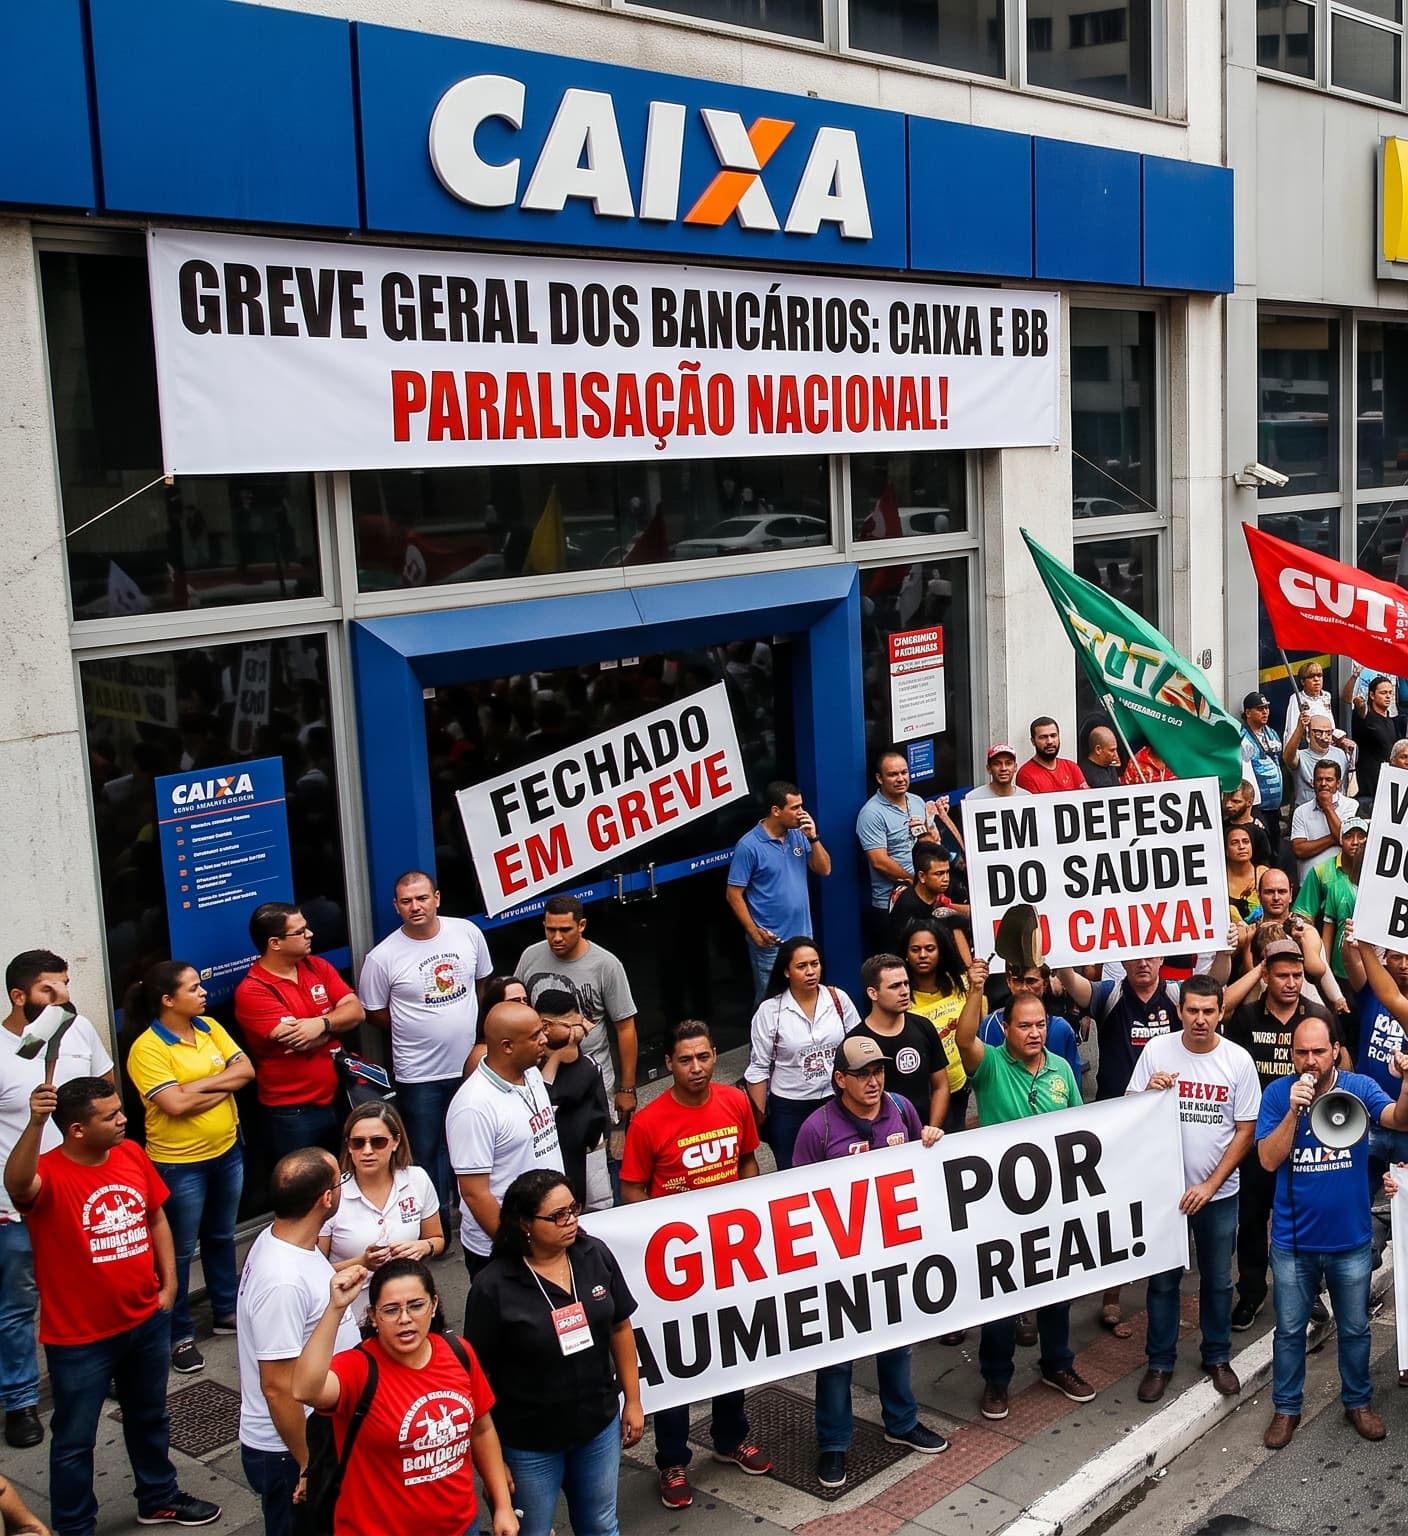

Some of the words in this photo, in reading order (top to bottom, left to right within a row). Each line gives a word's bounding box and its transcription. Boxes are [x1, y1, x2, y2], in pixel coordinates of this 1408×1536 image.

[428, 74, 874, 241] CAIXA
[179, 259, 367, 340] GREVE
[381, 271, 538, 345] GERAL
[550, 282, 639, 348] DOS
[652, 284, 880, 355] BANCÁRIOS:
[889, 301, 983, 356] CAIXA
[991, 307, 1004, 357] E
[1011, 308, 1049, 358] BB
[391, 360, 736, 451] PARALISAÇÃO
[748, 374, 950, 436] NACIONAL!
[1279, 567, 1395, 633] CUT
[171, 773, 255, 806] CAIXA
[487, 703, 711, 836] FECHADO
[493, 831, 572, 898] EM
[585, 749, 736, 853] GREVE
[974, 806, 1039, 853] EM
[1054, 790, 1213, 848] DEFESA
[986, 860, 1046, 907] DO
[1063, 838, 1209, 900] SAÚDE
[1068, 897, 1215, 954] CAIXA!
[682, 1136, 738, 1169] CUT
[1293, 1148, 1351, 1163] CAIXA
[645, 1168, 922, 1301] GREVE
[941, 1129, 1108, 1233] POR
[634, 1253, 957, 1389] AUMENTO
[976, 1200, 1147, 1301] REAL!
